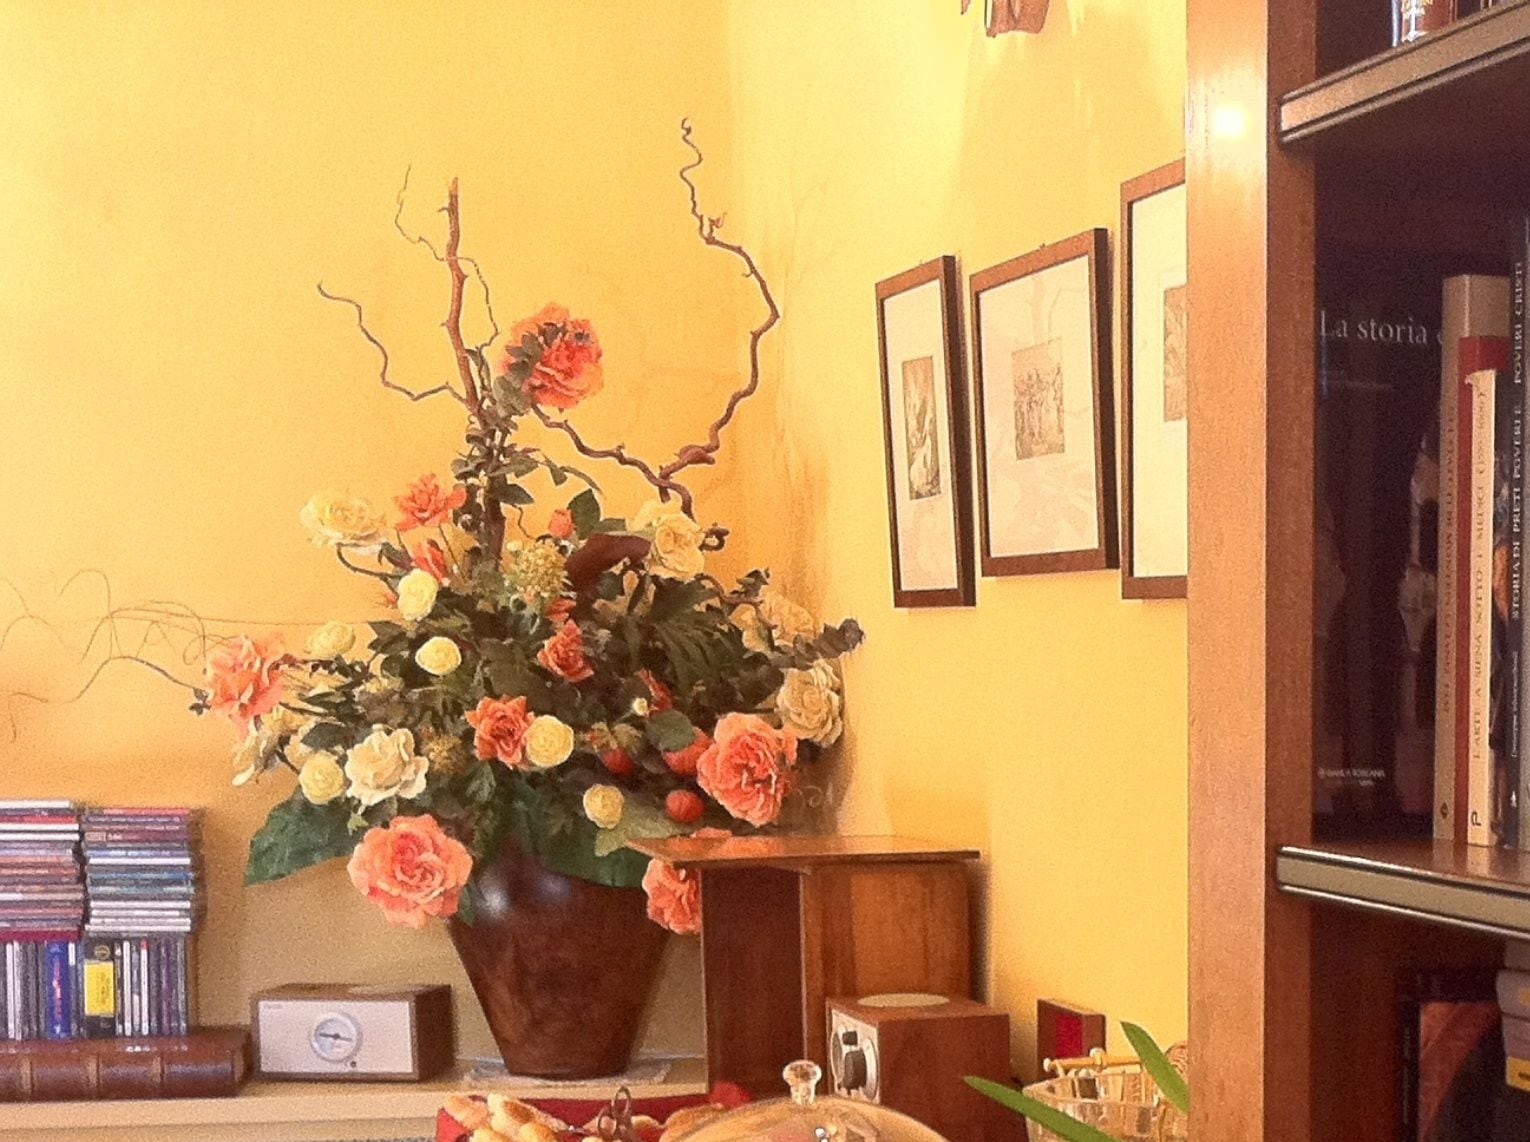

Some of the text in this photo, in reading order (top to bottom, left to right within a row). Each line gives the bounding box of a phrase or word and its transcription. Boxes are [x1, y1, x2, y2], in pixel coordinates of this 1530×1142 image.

[1320, 310, 1428, 344] La storia
[1512, 487, 1521, 533] PRETI
